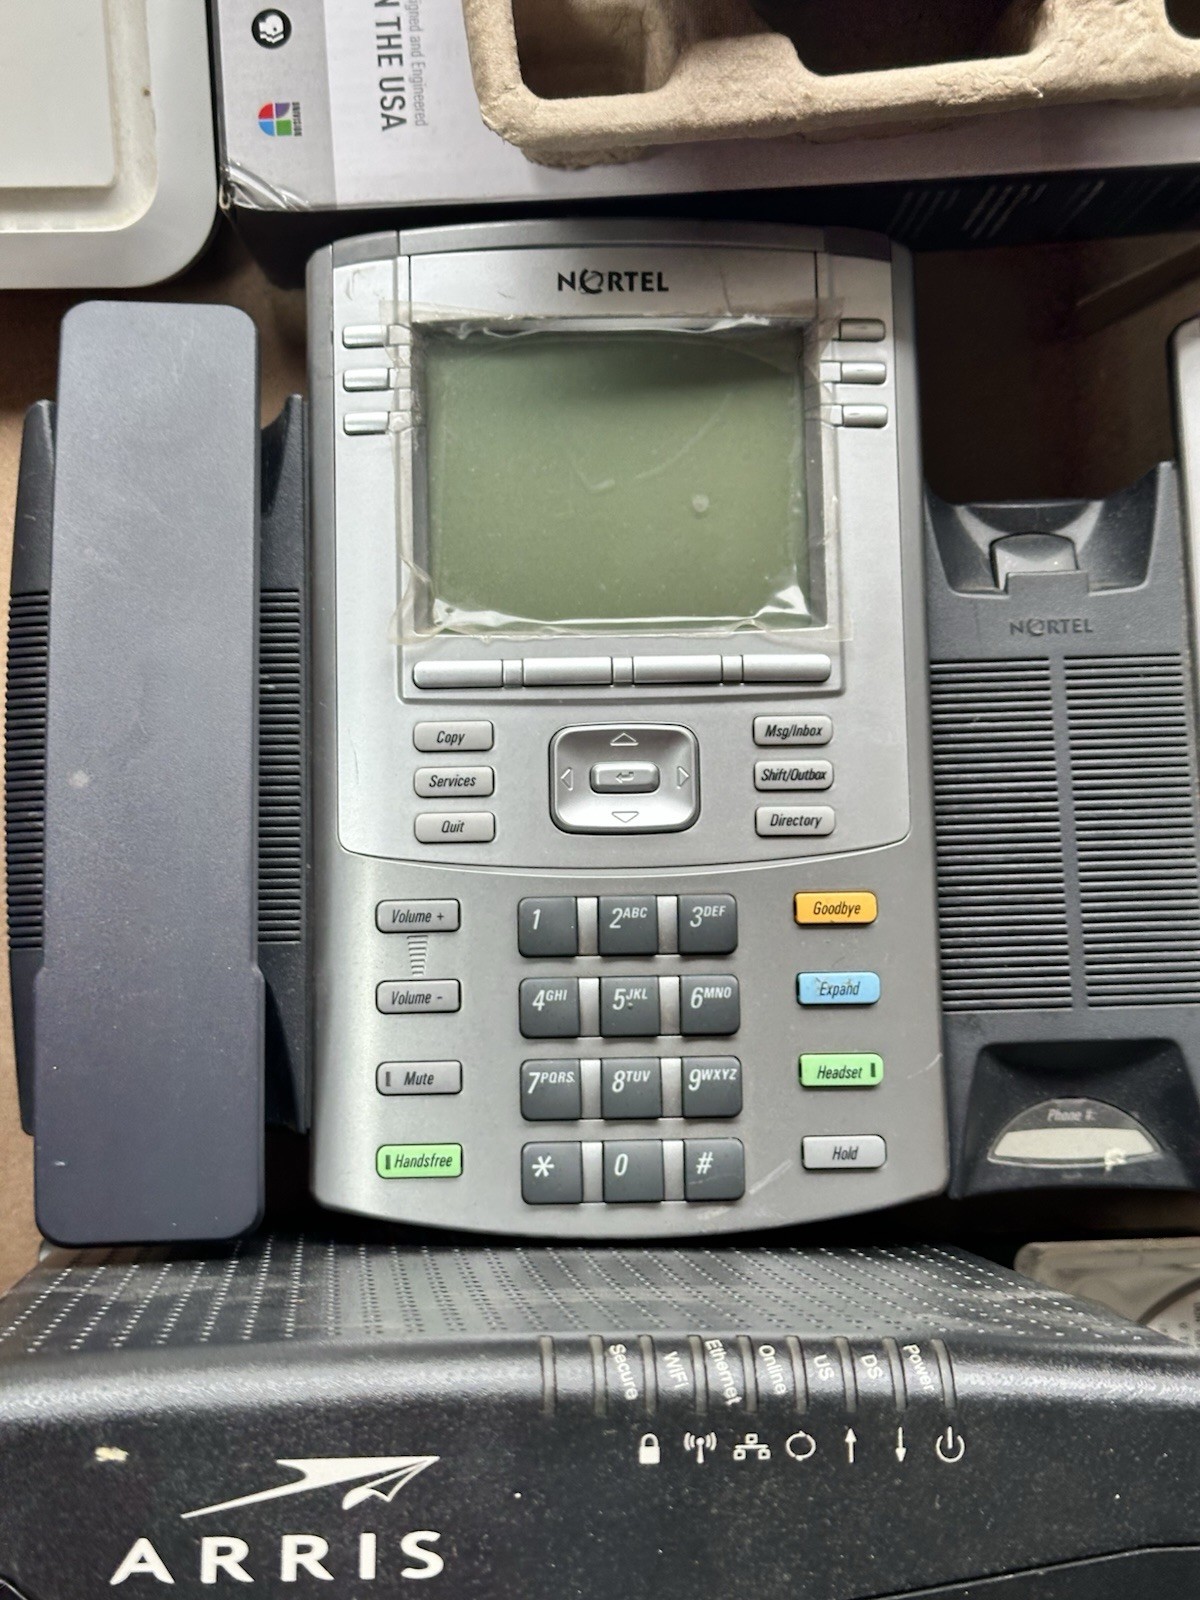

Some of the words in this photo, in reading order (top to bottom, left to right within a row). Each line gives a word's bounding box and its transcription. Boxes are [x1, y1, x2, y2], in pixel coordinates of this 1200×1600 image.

[375, 16, 404, 67] THE
[409, 36, 425, 58] and
[379, 76, 408, 132] USA
[408, 62, 429, 127] Engineered
[557, 267, 669, 295] NORTEL
[1009, 618, 1093, 637] NORTEL
[436, 730, 466, 746] Copy
[764, 724, 824, 740] Msg/Inbox
[428, 773, 477, 788] Services
[761, 768, 828, 782] Shift/Outbox
[441, 820, 465, 834] Quit
[770, 813, 823, 829] Directory
[391, 908, 432, 924] Volume
[532, 908, 541, 930] 1
[813, 901, 862, 918] Goodbye
[391, 990, 432, 1006] Volume
[820, 981, 861, 999] Expand
[403, 1071, 435, 1086] Mute
[817, 1065, 863, 1080] Headset
[1047, 1108, 1081, 1122] Phone
[394, 1152, 453, 1169] Handsfree
[832, 1146, 859, 1160] Hold
[614, 1153, 628, 1176] 0
[695, 1151, 714, 1175] #
[609, 1343, 639, 1400] Secure
[704, 1339, 742, 1406] Ethernet
[758, 1344, 787, 1395] Online
[814, 1354, 835, 1381] US
[861, 1354, 884, 1380] DS
[902, 1344, 935, 1392] Power
[109, 1530, 445, 1586] ARRIS
